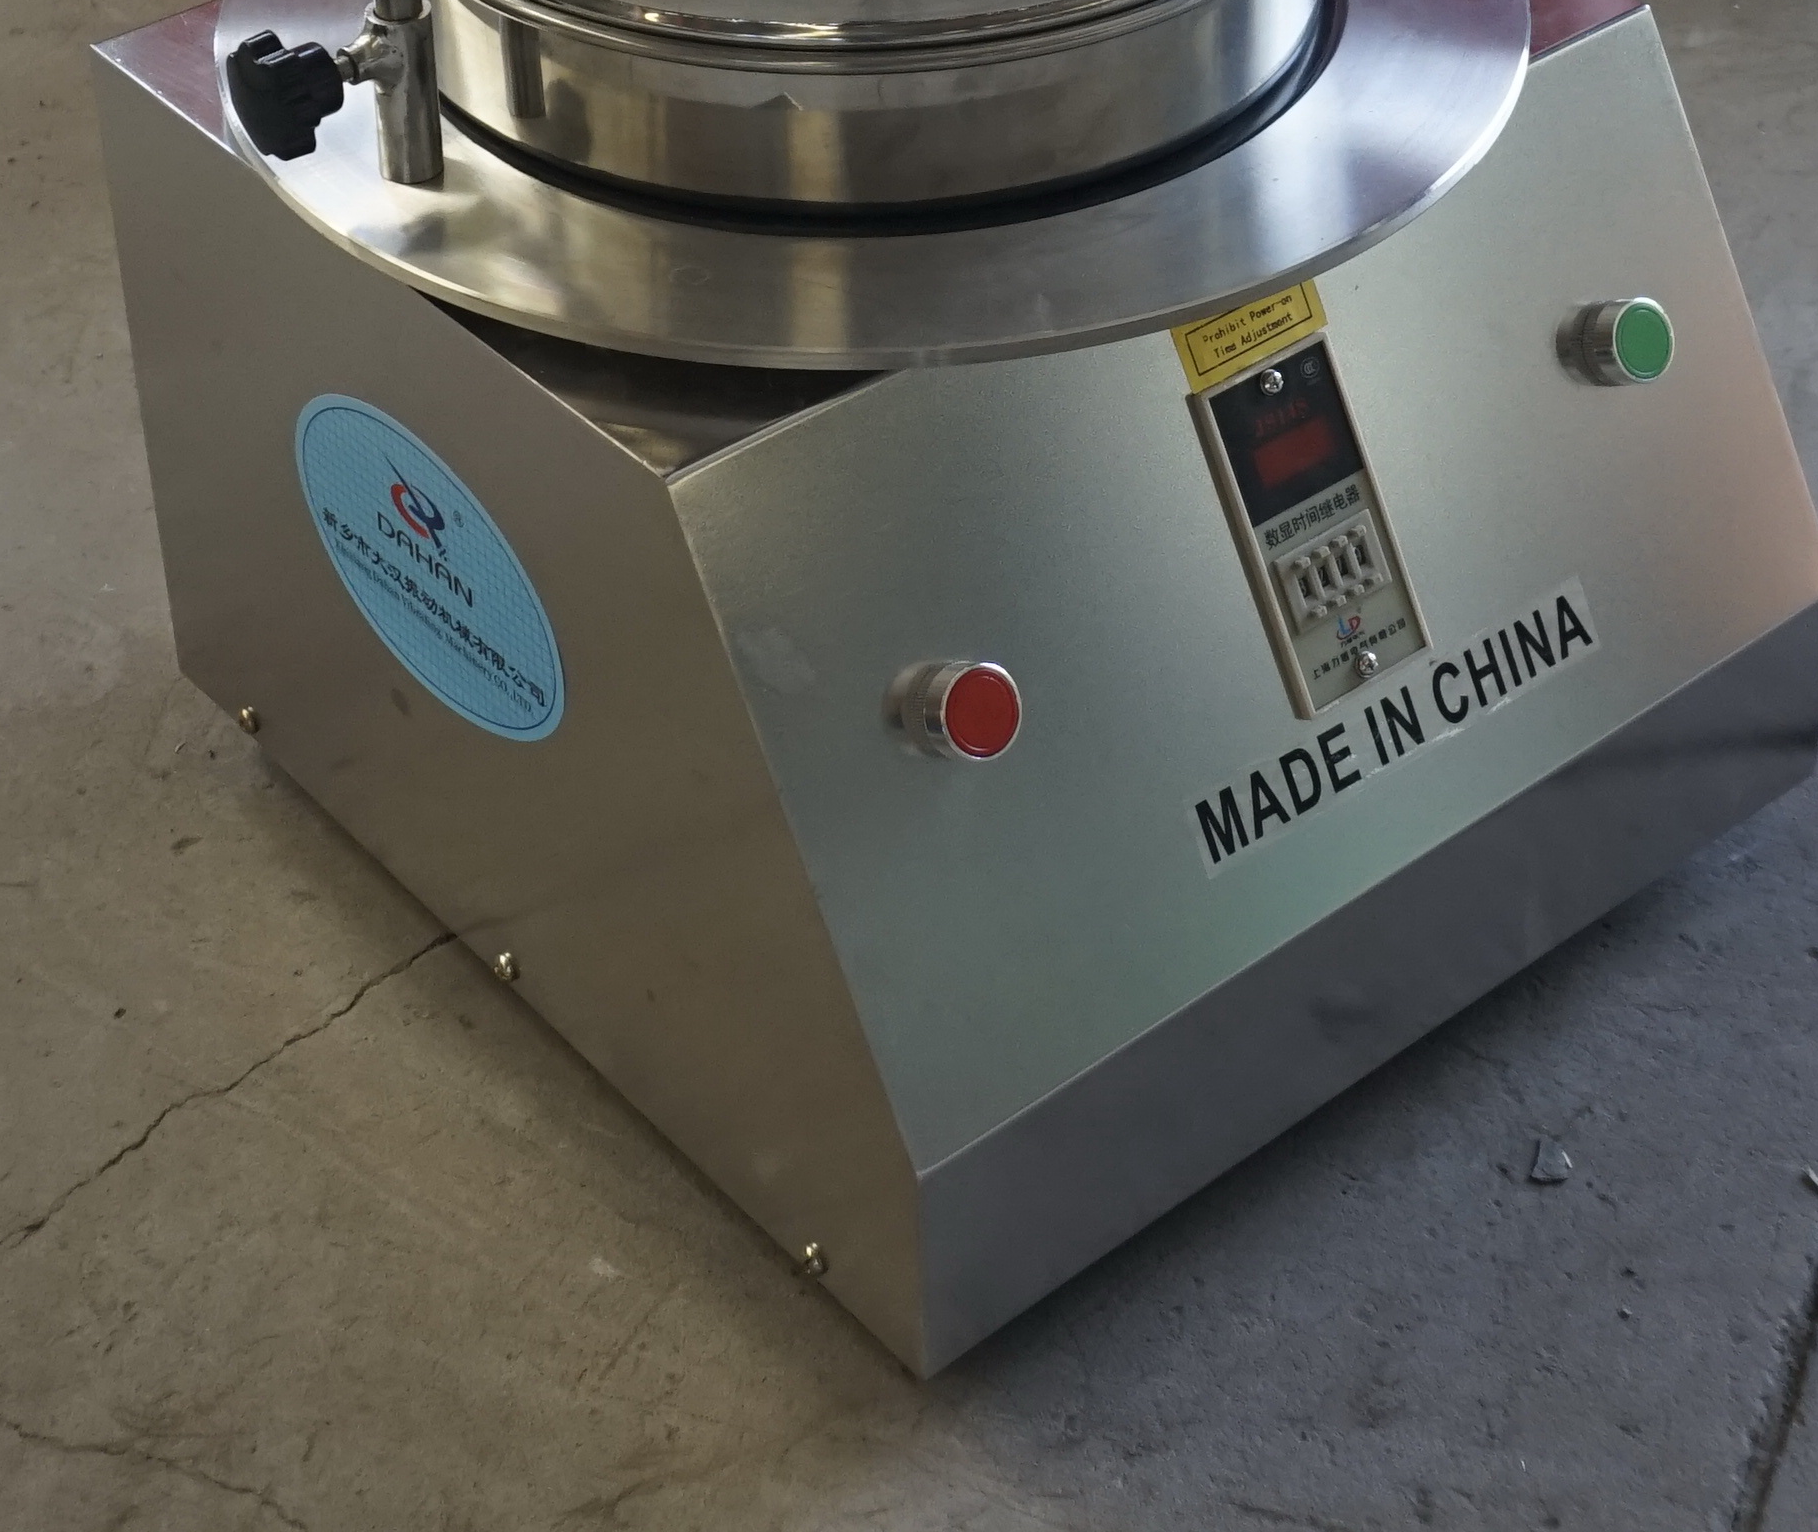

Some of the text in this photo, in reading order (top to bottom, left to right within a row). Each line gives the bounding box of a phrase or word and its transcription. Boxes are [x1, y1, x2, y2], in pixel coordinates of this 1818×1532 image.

[1203, 295, 1292, 343] Prohibit Power-on
[1241, 312, 1293, 346] Adjustment
[1264, 484, 1360, 550] 数显时间继电器
[377, 510, 473, 608] DAHAN
[322, 508, 546, 707] 新乡市大汉振动机械有限公司
[1195, 596, 1593, 864] MADE IN CHINA
